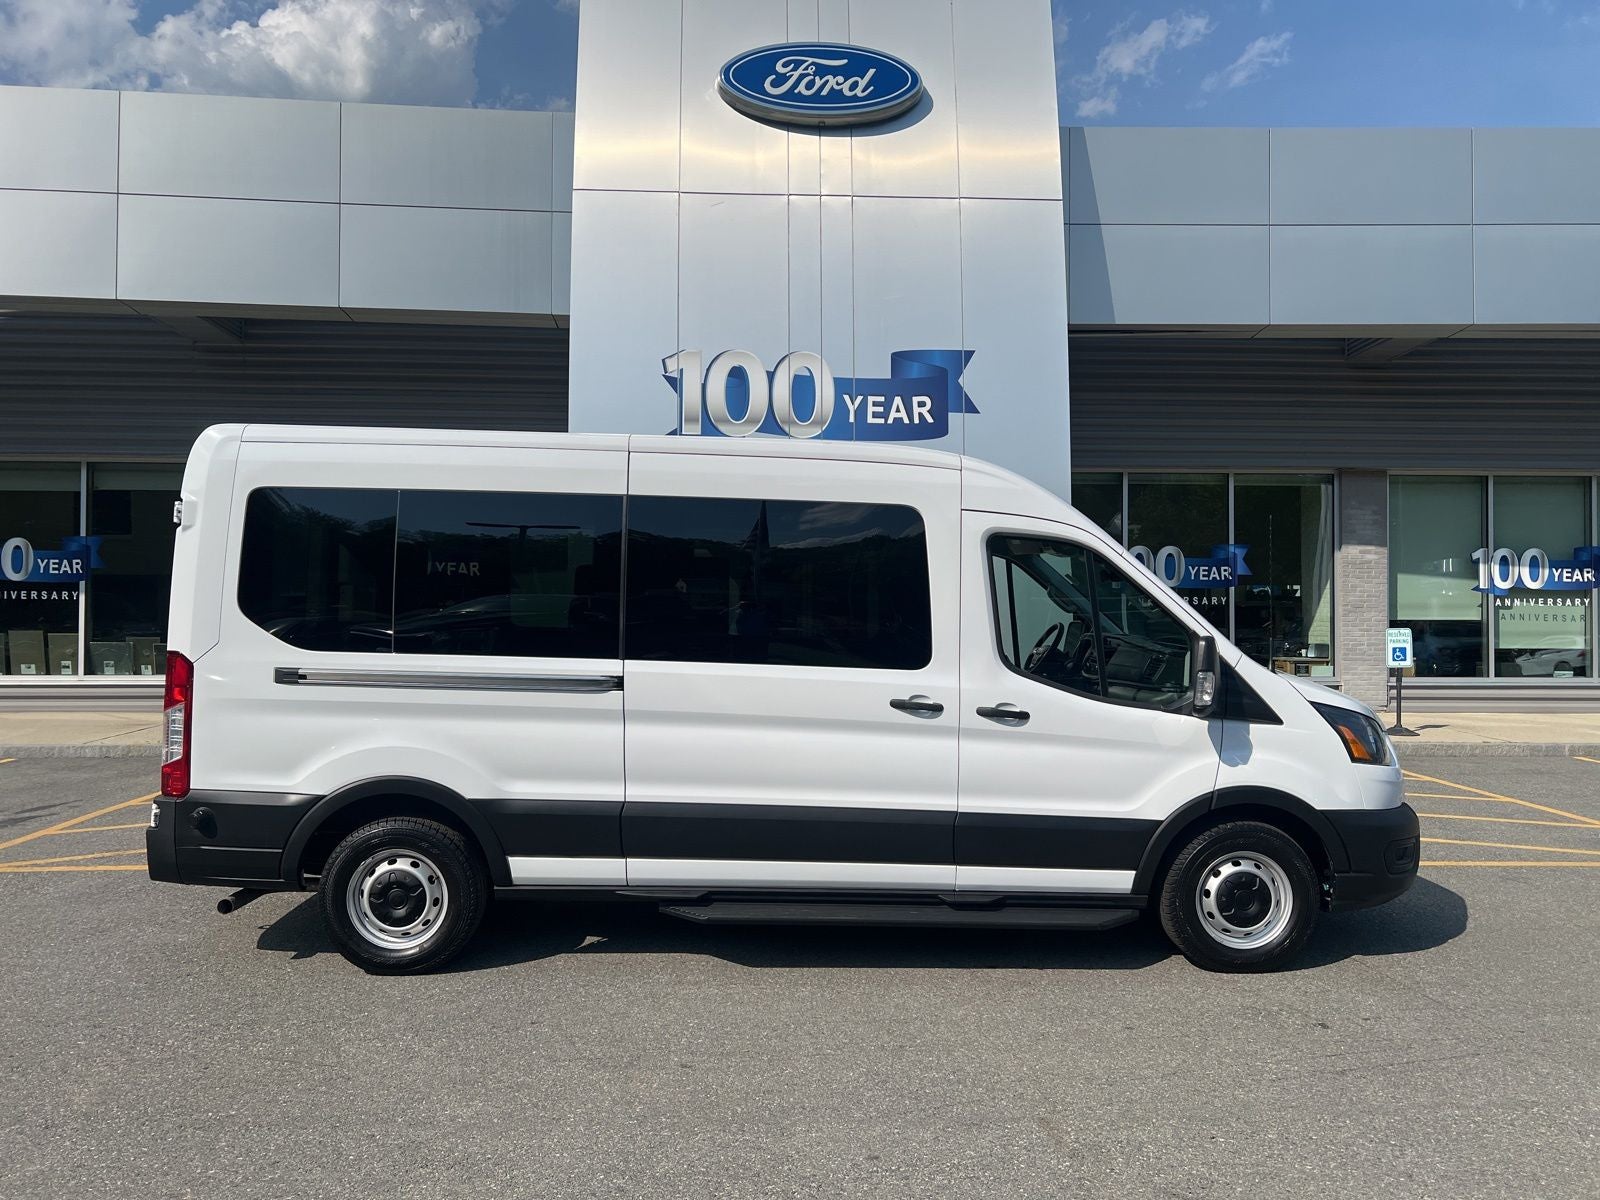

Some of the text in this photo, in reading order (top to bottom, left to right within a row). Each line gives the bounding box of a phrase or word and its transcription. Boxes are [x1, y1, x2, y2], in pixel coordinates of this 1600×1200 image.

[764, 56, 877, 97] Ford
[662, 349, 934, 438] 100 YEAR
[37, 559, 83, 574] YEAR
[1188, 566, 1233, 581] YEAR
[1471, 548, 1596, 590] 100 YEAR
[1495, 598, 1591, 607] ANNIVERSARY
